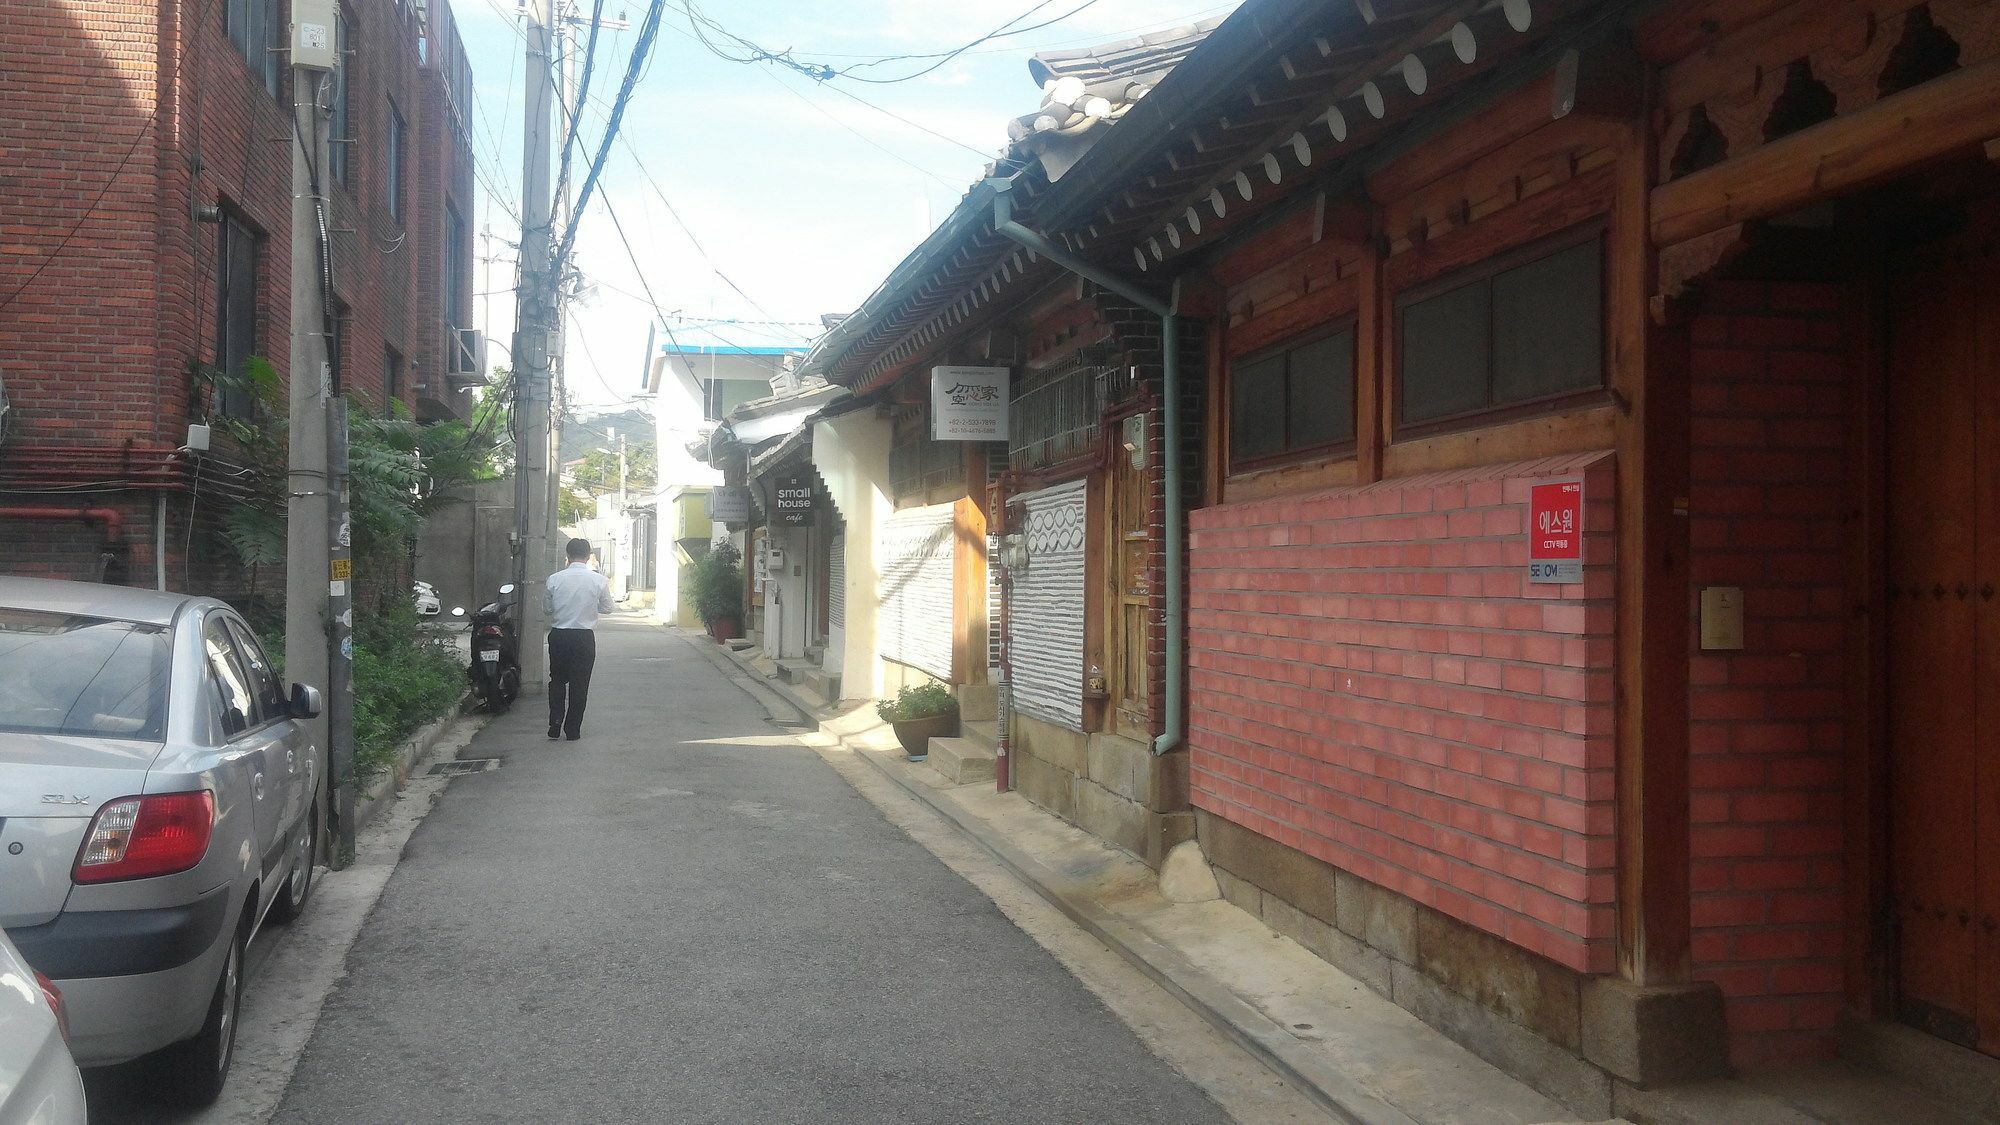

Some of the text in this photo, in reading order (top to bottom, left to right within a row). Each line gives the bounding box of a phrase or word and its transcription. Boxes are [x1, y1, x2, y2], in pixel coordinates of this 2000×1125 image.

[778, 487, 811, 498] small
[777, 499, 811, 508] house
[1539, 509, 1573, 535] 에스원
[1543, 540, 1556, 549] CCTV
